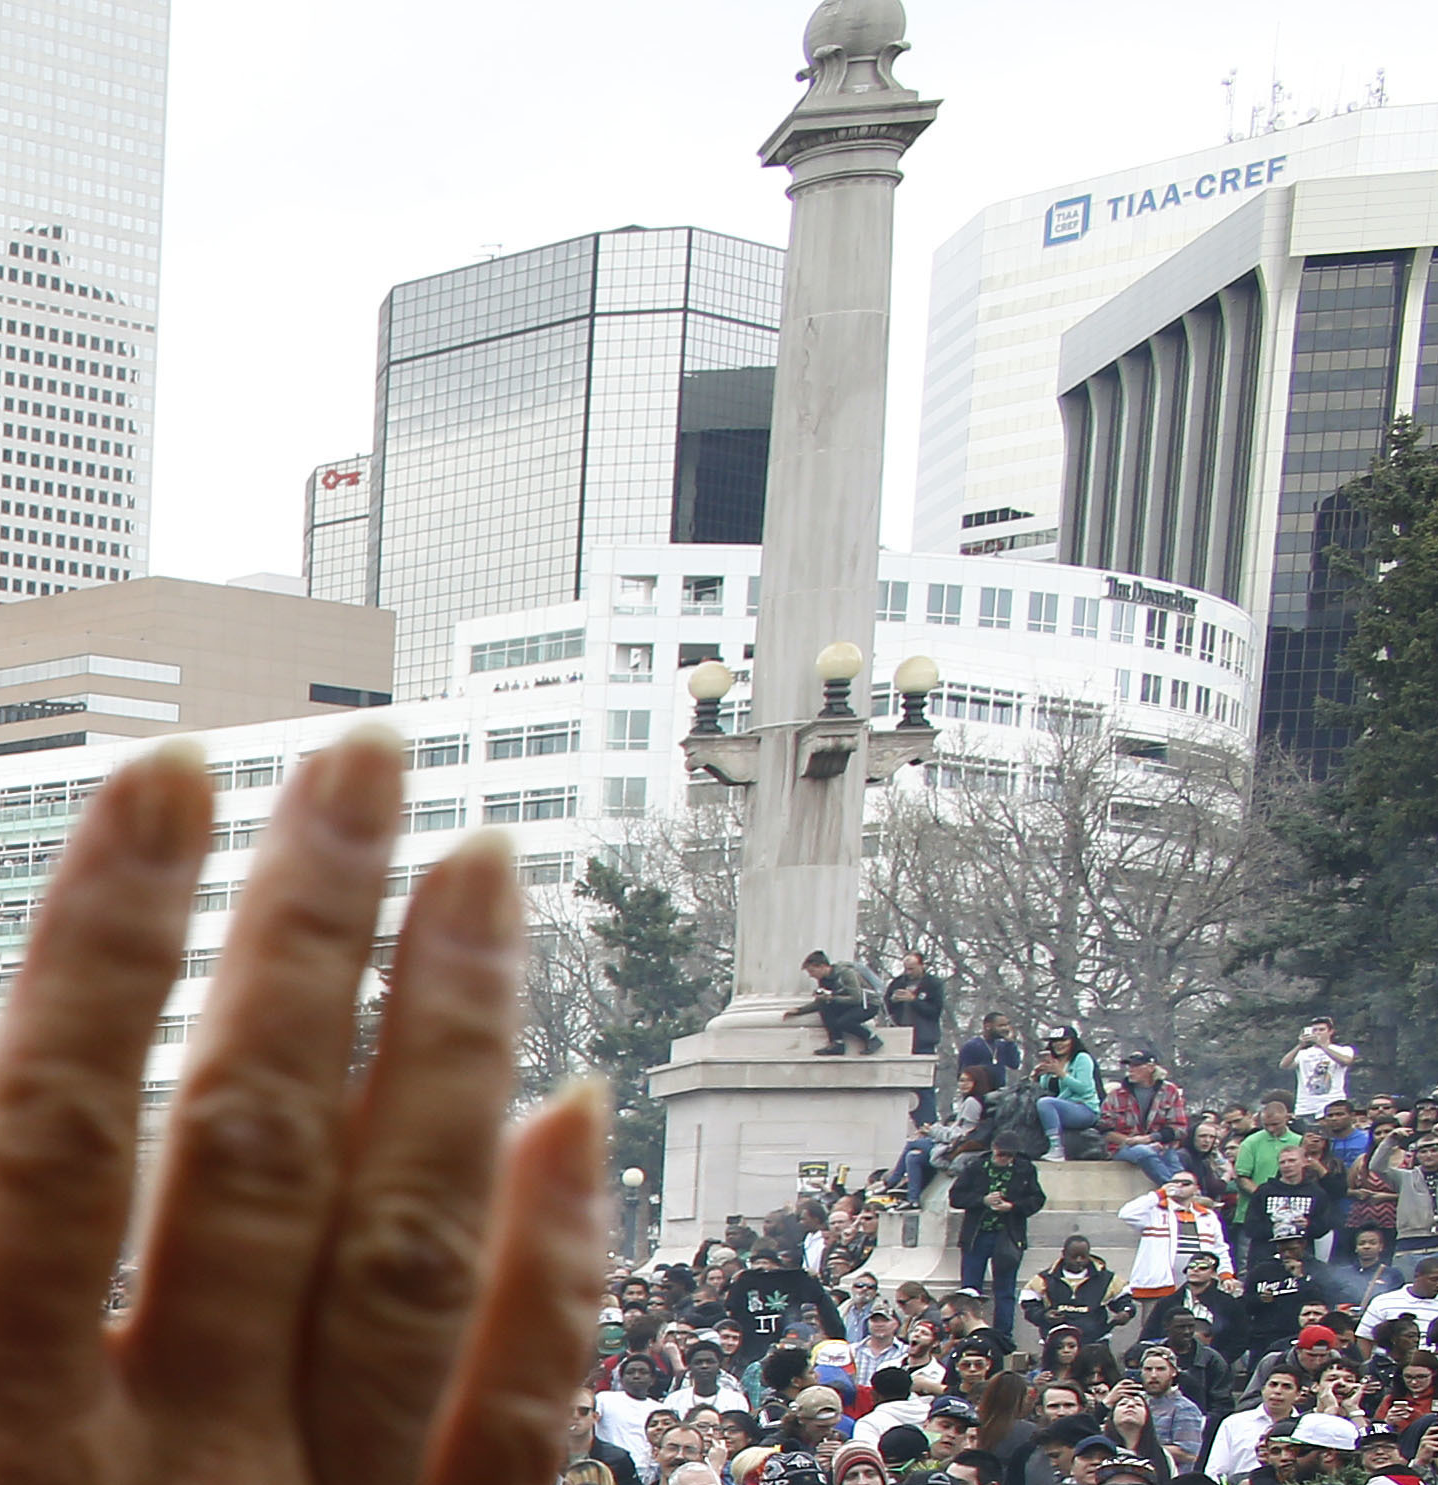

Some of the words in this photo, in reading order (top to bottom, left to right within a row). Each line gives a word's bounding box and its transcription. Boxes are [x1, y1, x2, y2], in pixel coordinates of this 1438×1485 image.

[1106, 156, 1287, 222] TIAA-CREF
[1055, 211, 1078, 222] TIAA
[1054, 221, 1078, 233] CREF
[755, 1314, 782, 1334] IT
